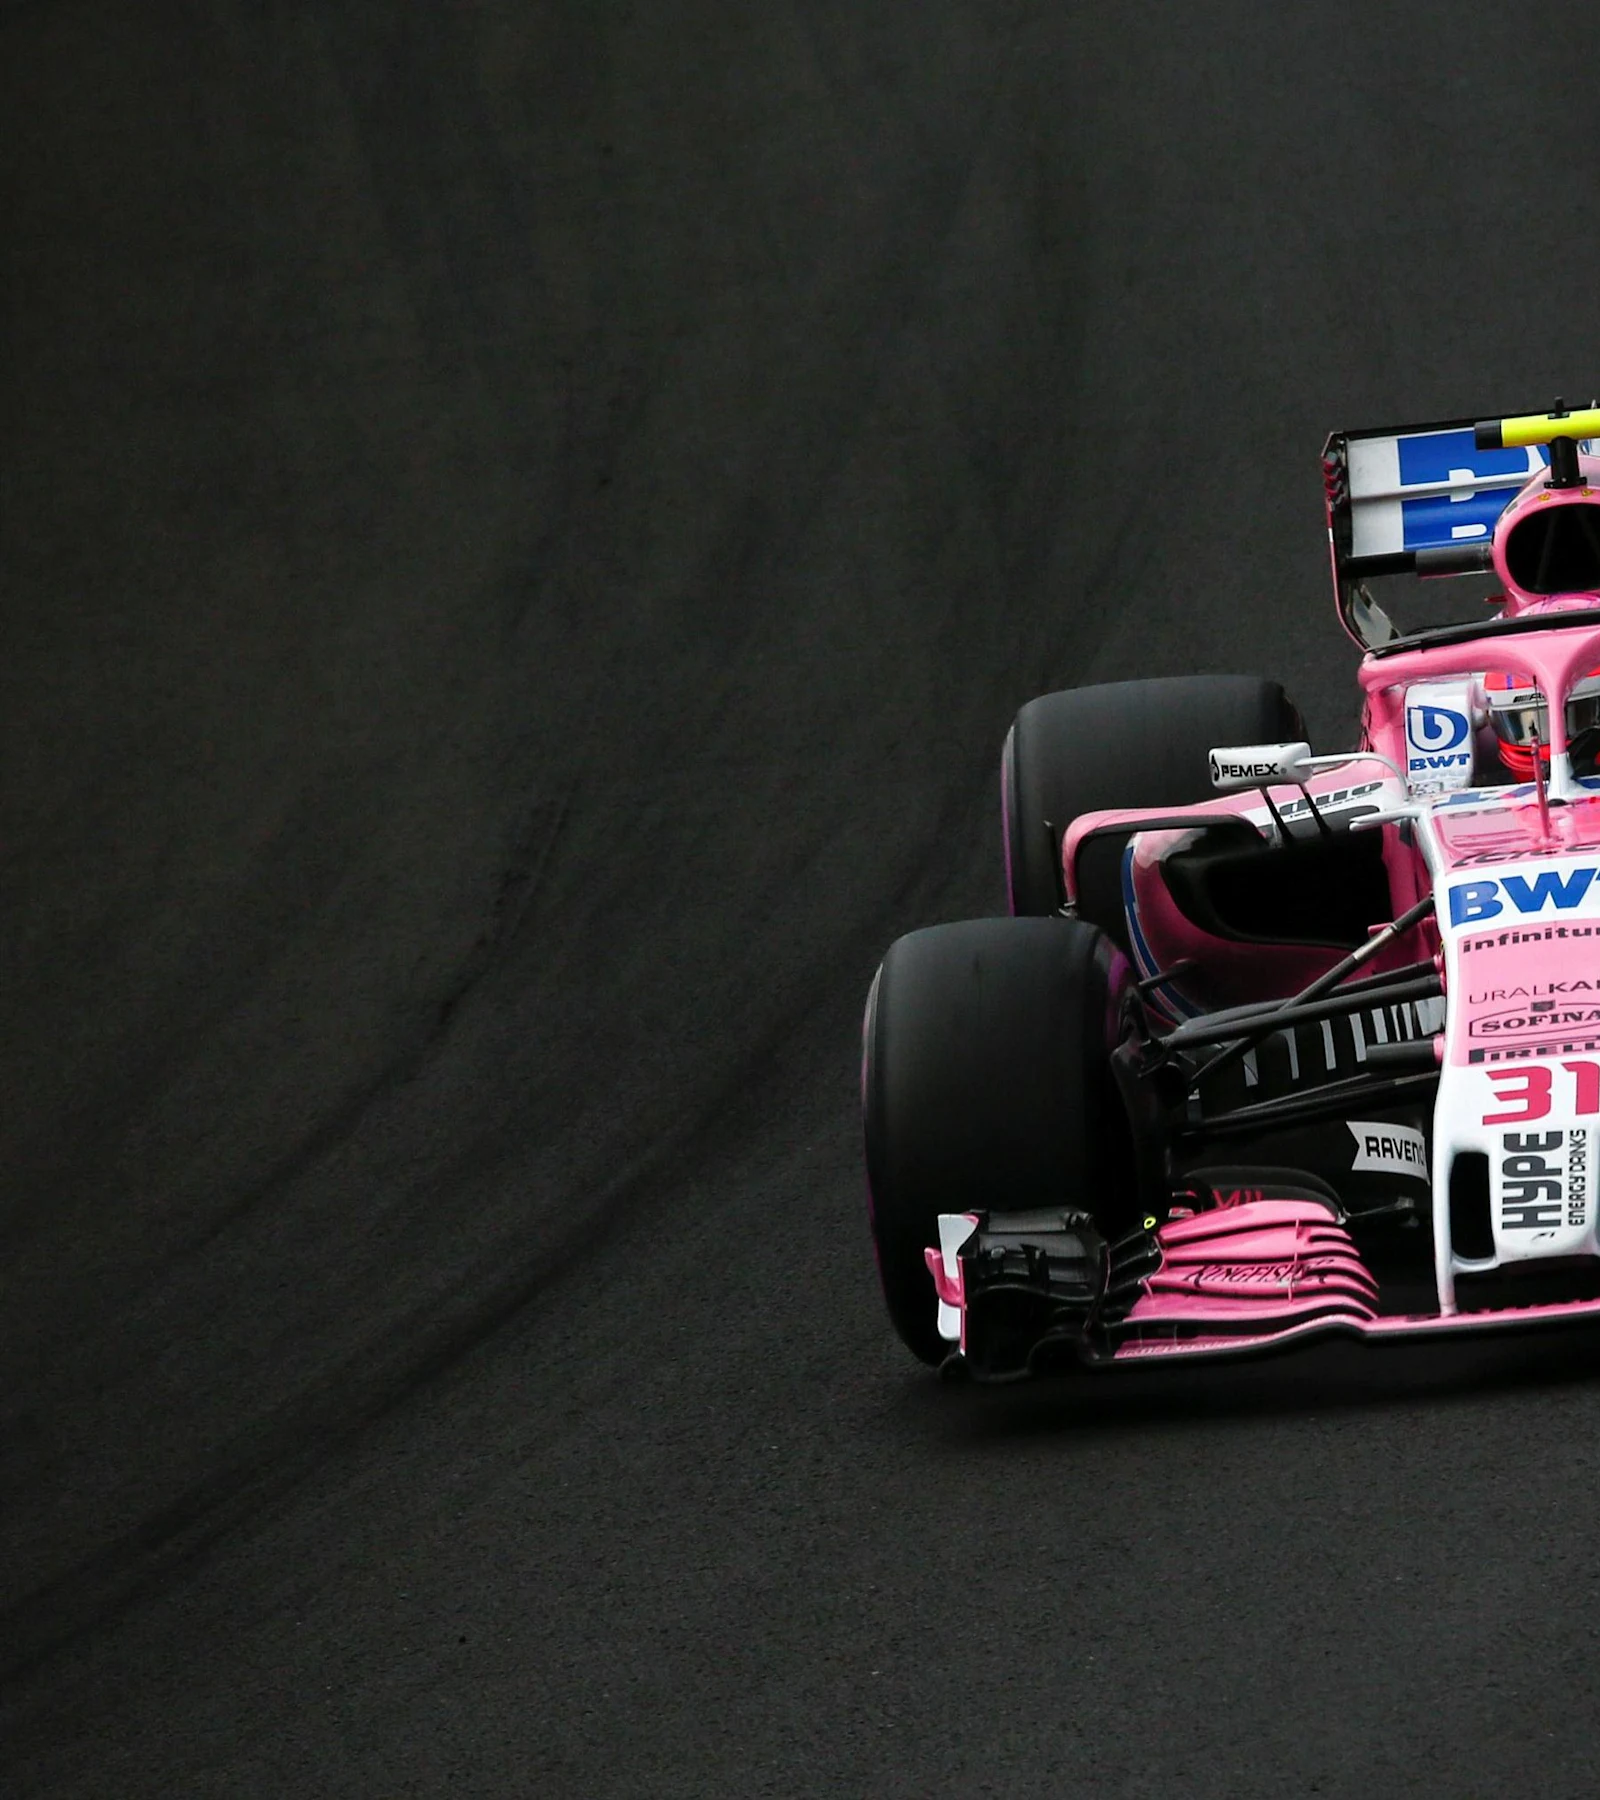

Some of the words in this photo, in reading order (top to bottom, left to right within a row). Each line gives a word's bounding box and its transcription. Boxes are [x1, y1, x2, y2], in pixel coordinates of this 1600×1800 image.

[1221, 763, 1280, 778] PEMEX
[1409, 753, 1471, 771] BWT
[1482, 1061, 1600, 1126] 31
[1365, 1136, 1425, 1166] RAVENO
[1568, 1129, 1587, 1172] DRINKS
[1502, 1130, 1563, 1230] HYPE
